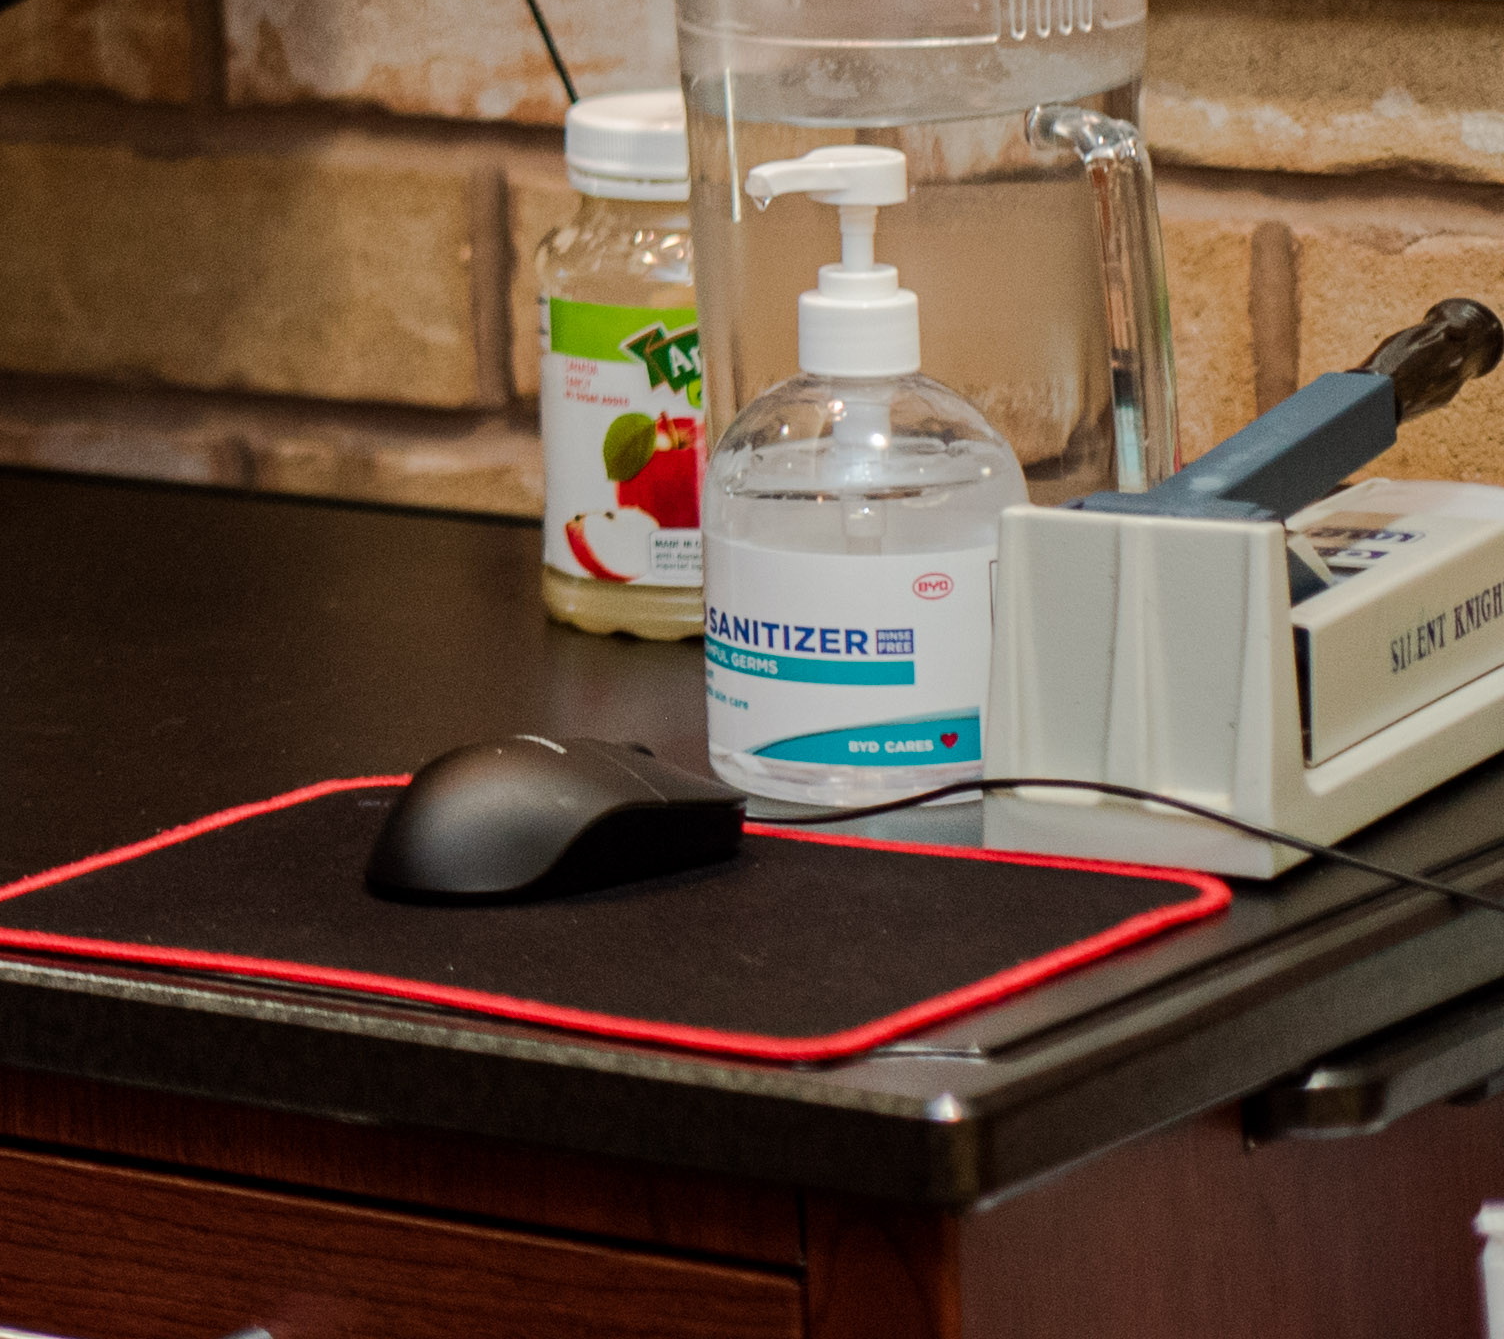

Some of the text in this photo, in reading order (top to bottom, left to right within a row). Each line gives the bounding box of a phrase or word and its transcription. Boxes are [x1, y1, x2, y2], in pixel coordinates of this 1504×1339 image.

[709, 606, 868, 656] SANITIZER
[878, 631, 911, 642] RINSE
[1390, 581, 1504, 674] SILENT KNIGH
[878, 642, 913, 653] FREE
[731, 652, 778, 675] GERMS
[848, 739, 934, 754] BYD CARES
